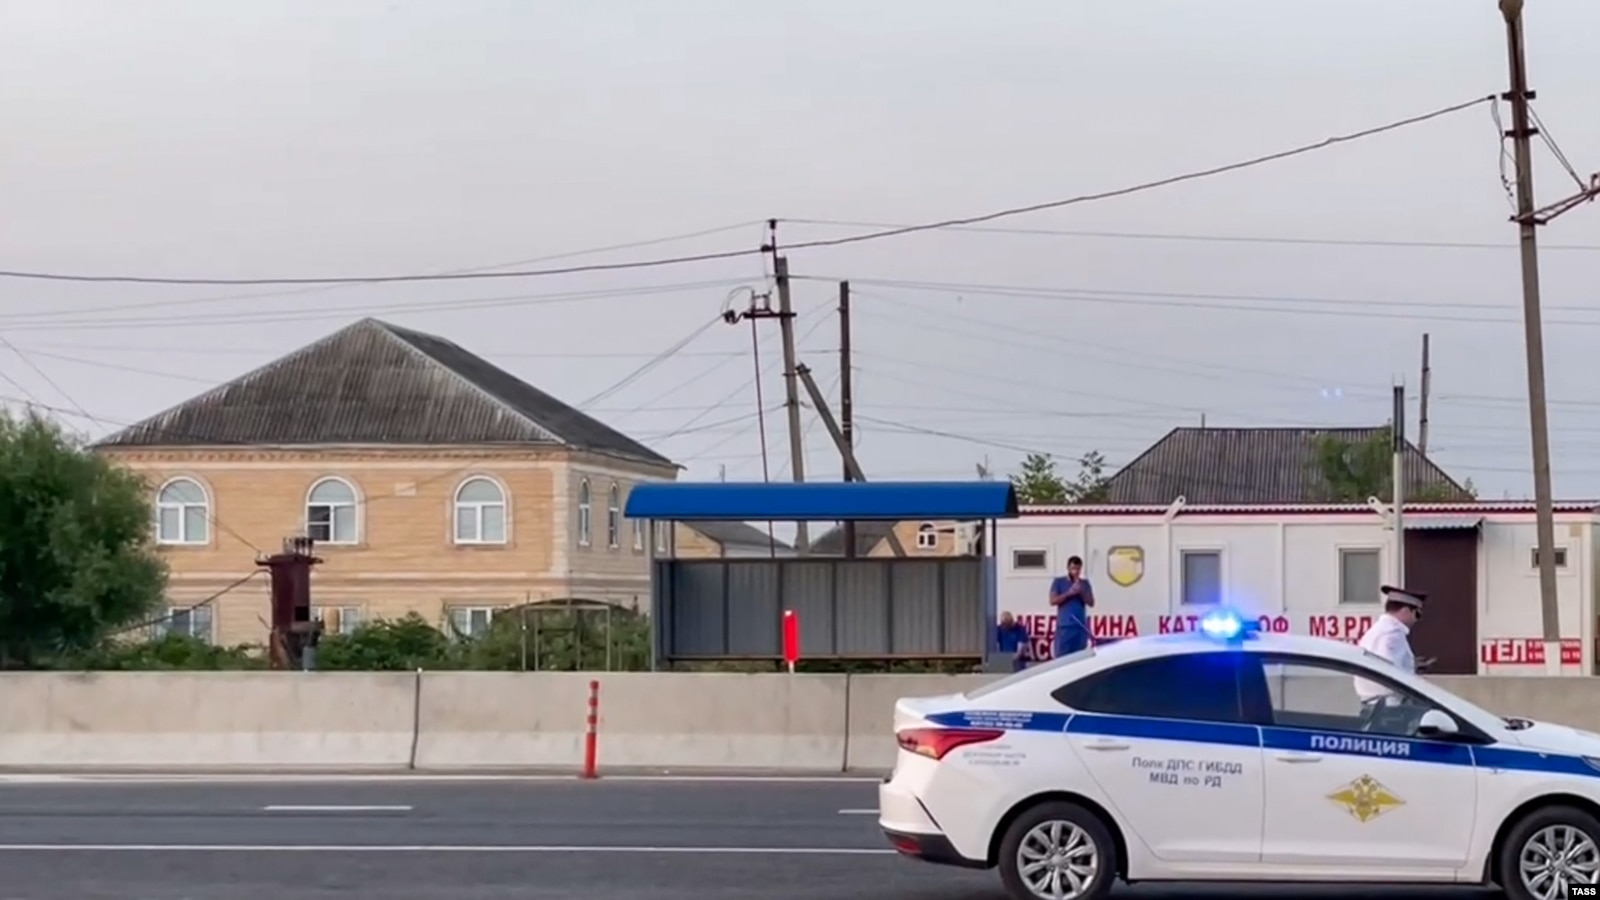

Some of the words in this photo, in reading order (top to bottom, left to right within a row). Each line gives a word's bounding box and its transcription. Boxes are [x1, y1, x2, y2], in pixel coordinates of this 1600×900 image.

[1158, 615, 1289, 634] КАТОФ
[1481, 640, 1527, 662] ТЕЛ
[1310, 735, 1411, 756] ПОЛИЦИЯ
[1132, 756, 1162, 768] Полк
[1166, 758, 1195, 771] ДПС
[1198, 760, 1243, 774] ГИБДД
[1149, 772, 1178, 785] МВД
[1183, 775, 1199, 785] по
[1204, 775, 1222, 787] РД
